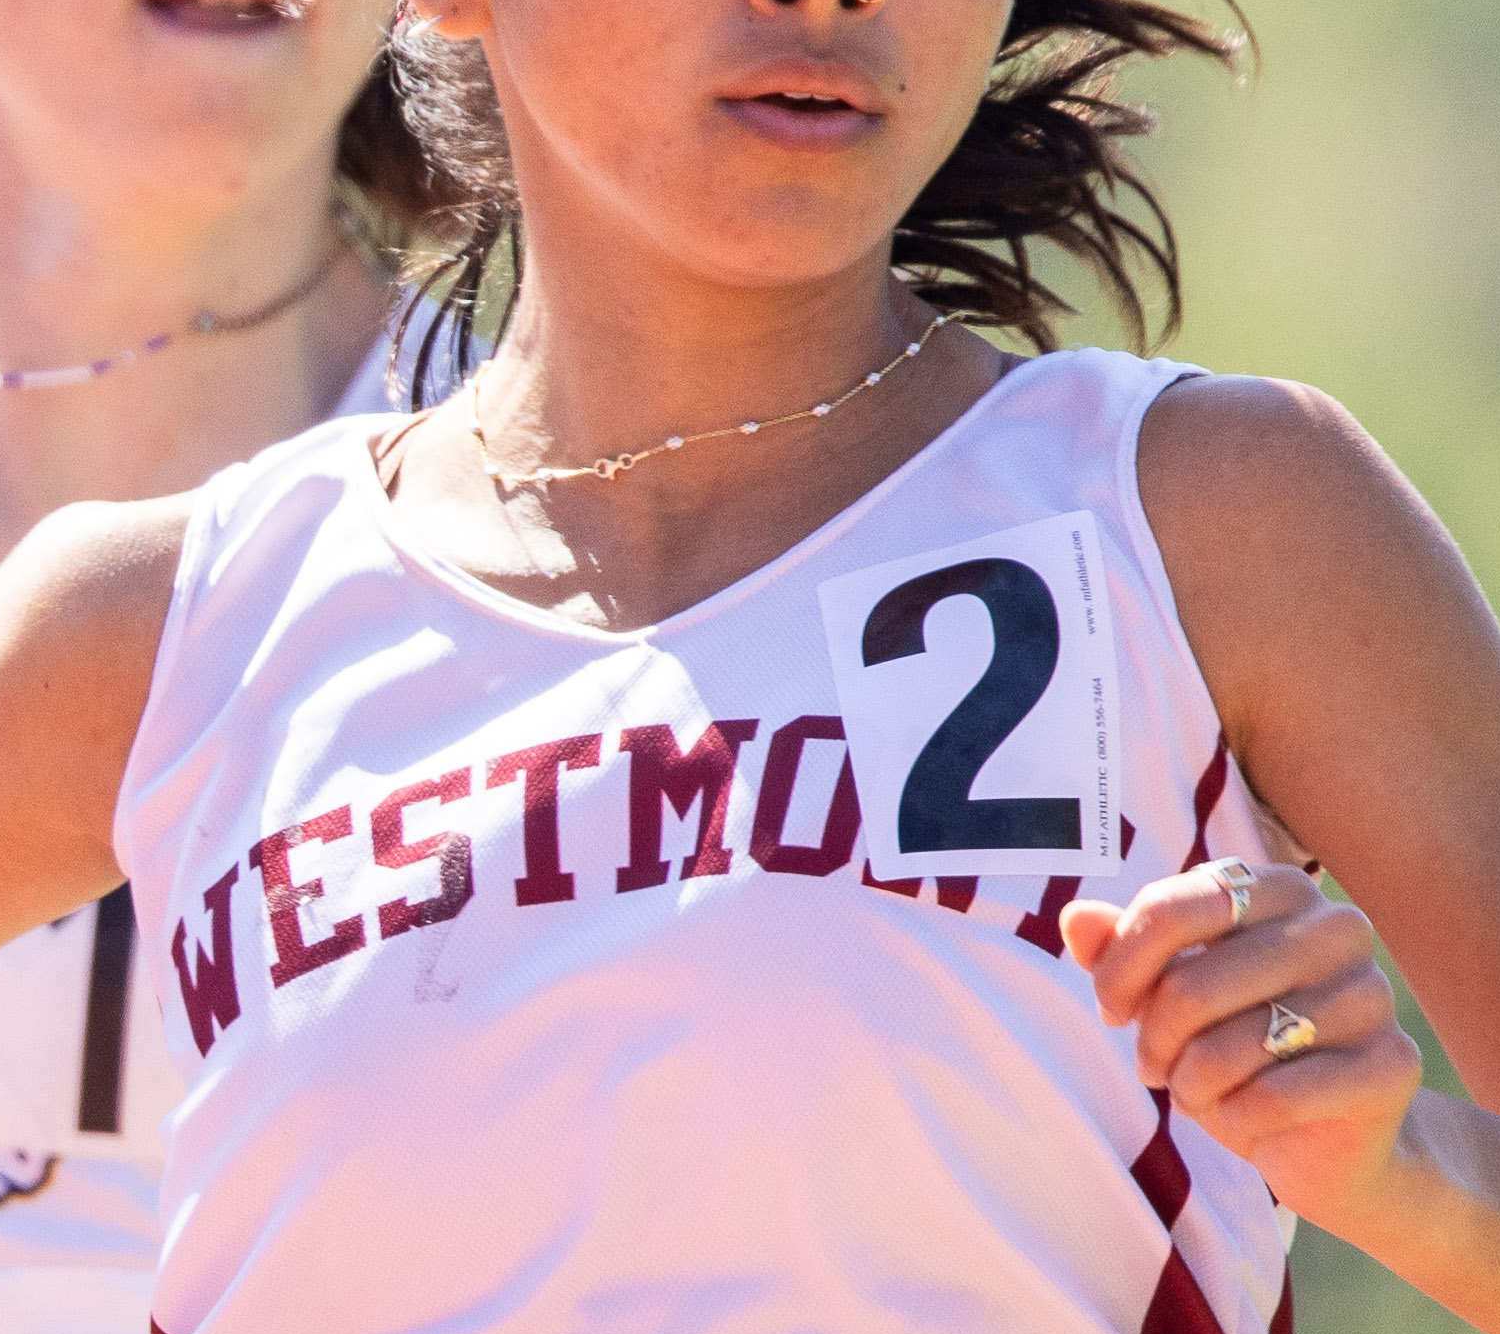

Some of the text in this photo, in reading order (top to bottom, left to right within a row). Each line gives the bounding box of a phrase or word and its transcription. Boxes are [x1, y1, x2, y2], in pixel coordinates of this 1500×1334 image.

[1071, 530, 1093, 601] mfathletic.com
[861, 557, 1083, 855] 2
[1092, 677, 1107, 728] 556-7464
[1097, 731, 1108, 760] (800)
[1098, 767, 1109, 830] ATHLETIC
[171, 715, 1136, 1060] WESTMO
